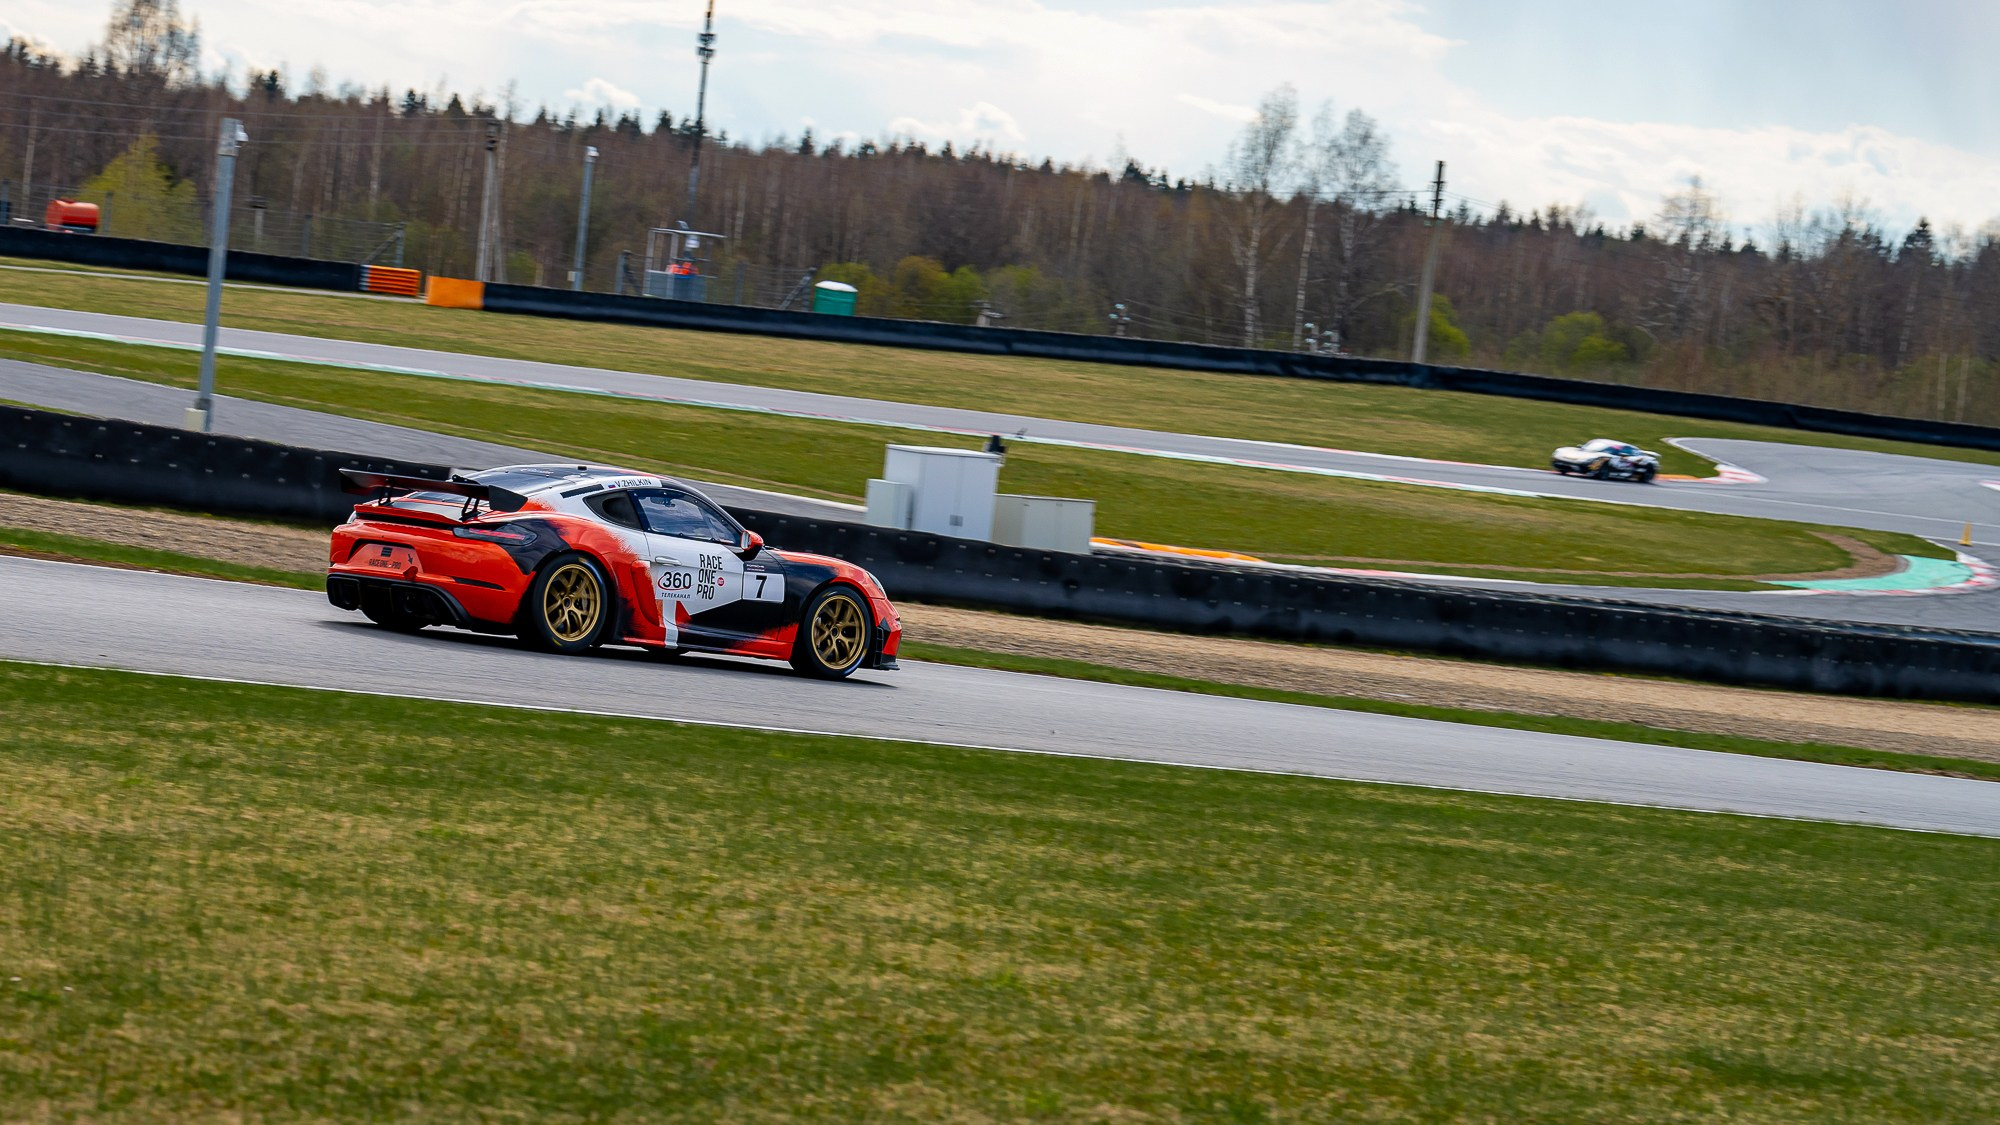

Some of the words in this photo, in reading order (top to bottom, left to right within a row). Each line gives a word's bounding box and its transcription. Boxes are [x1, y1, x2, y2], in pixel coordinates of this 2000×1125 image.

[699, 553, 723, 570] RACE
[662, 571, 692, 589] 360
[698, 569, 717, 585] ONE
[696, 584, 715, 600] PRO
[755, 575, 768, 599] 7
